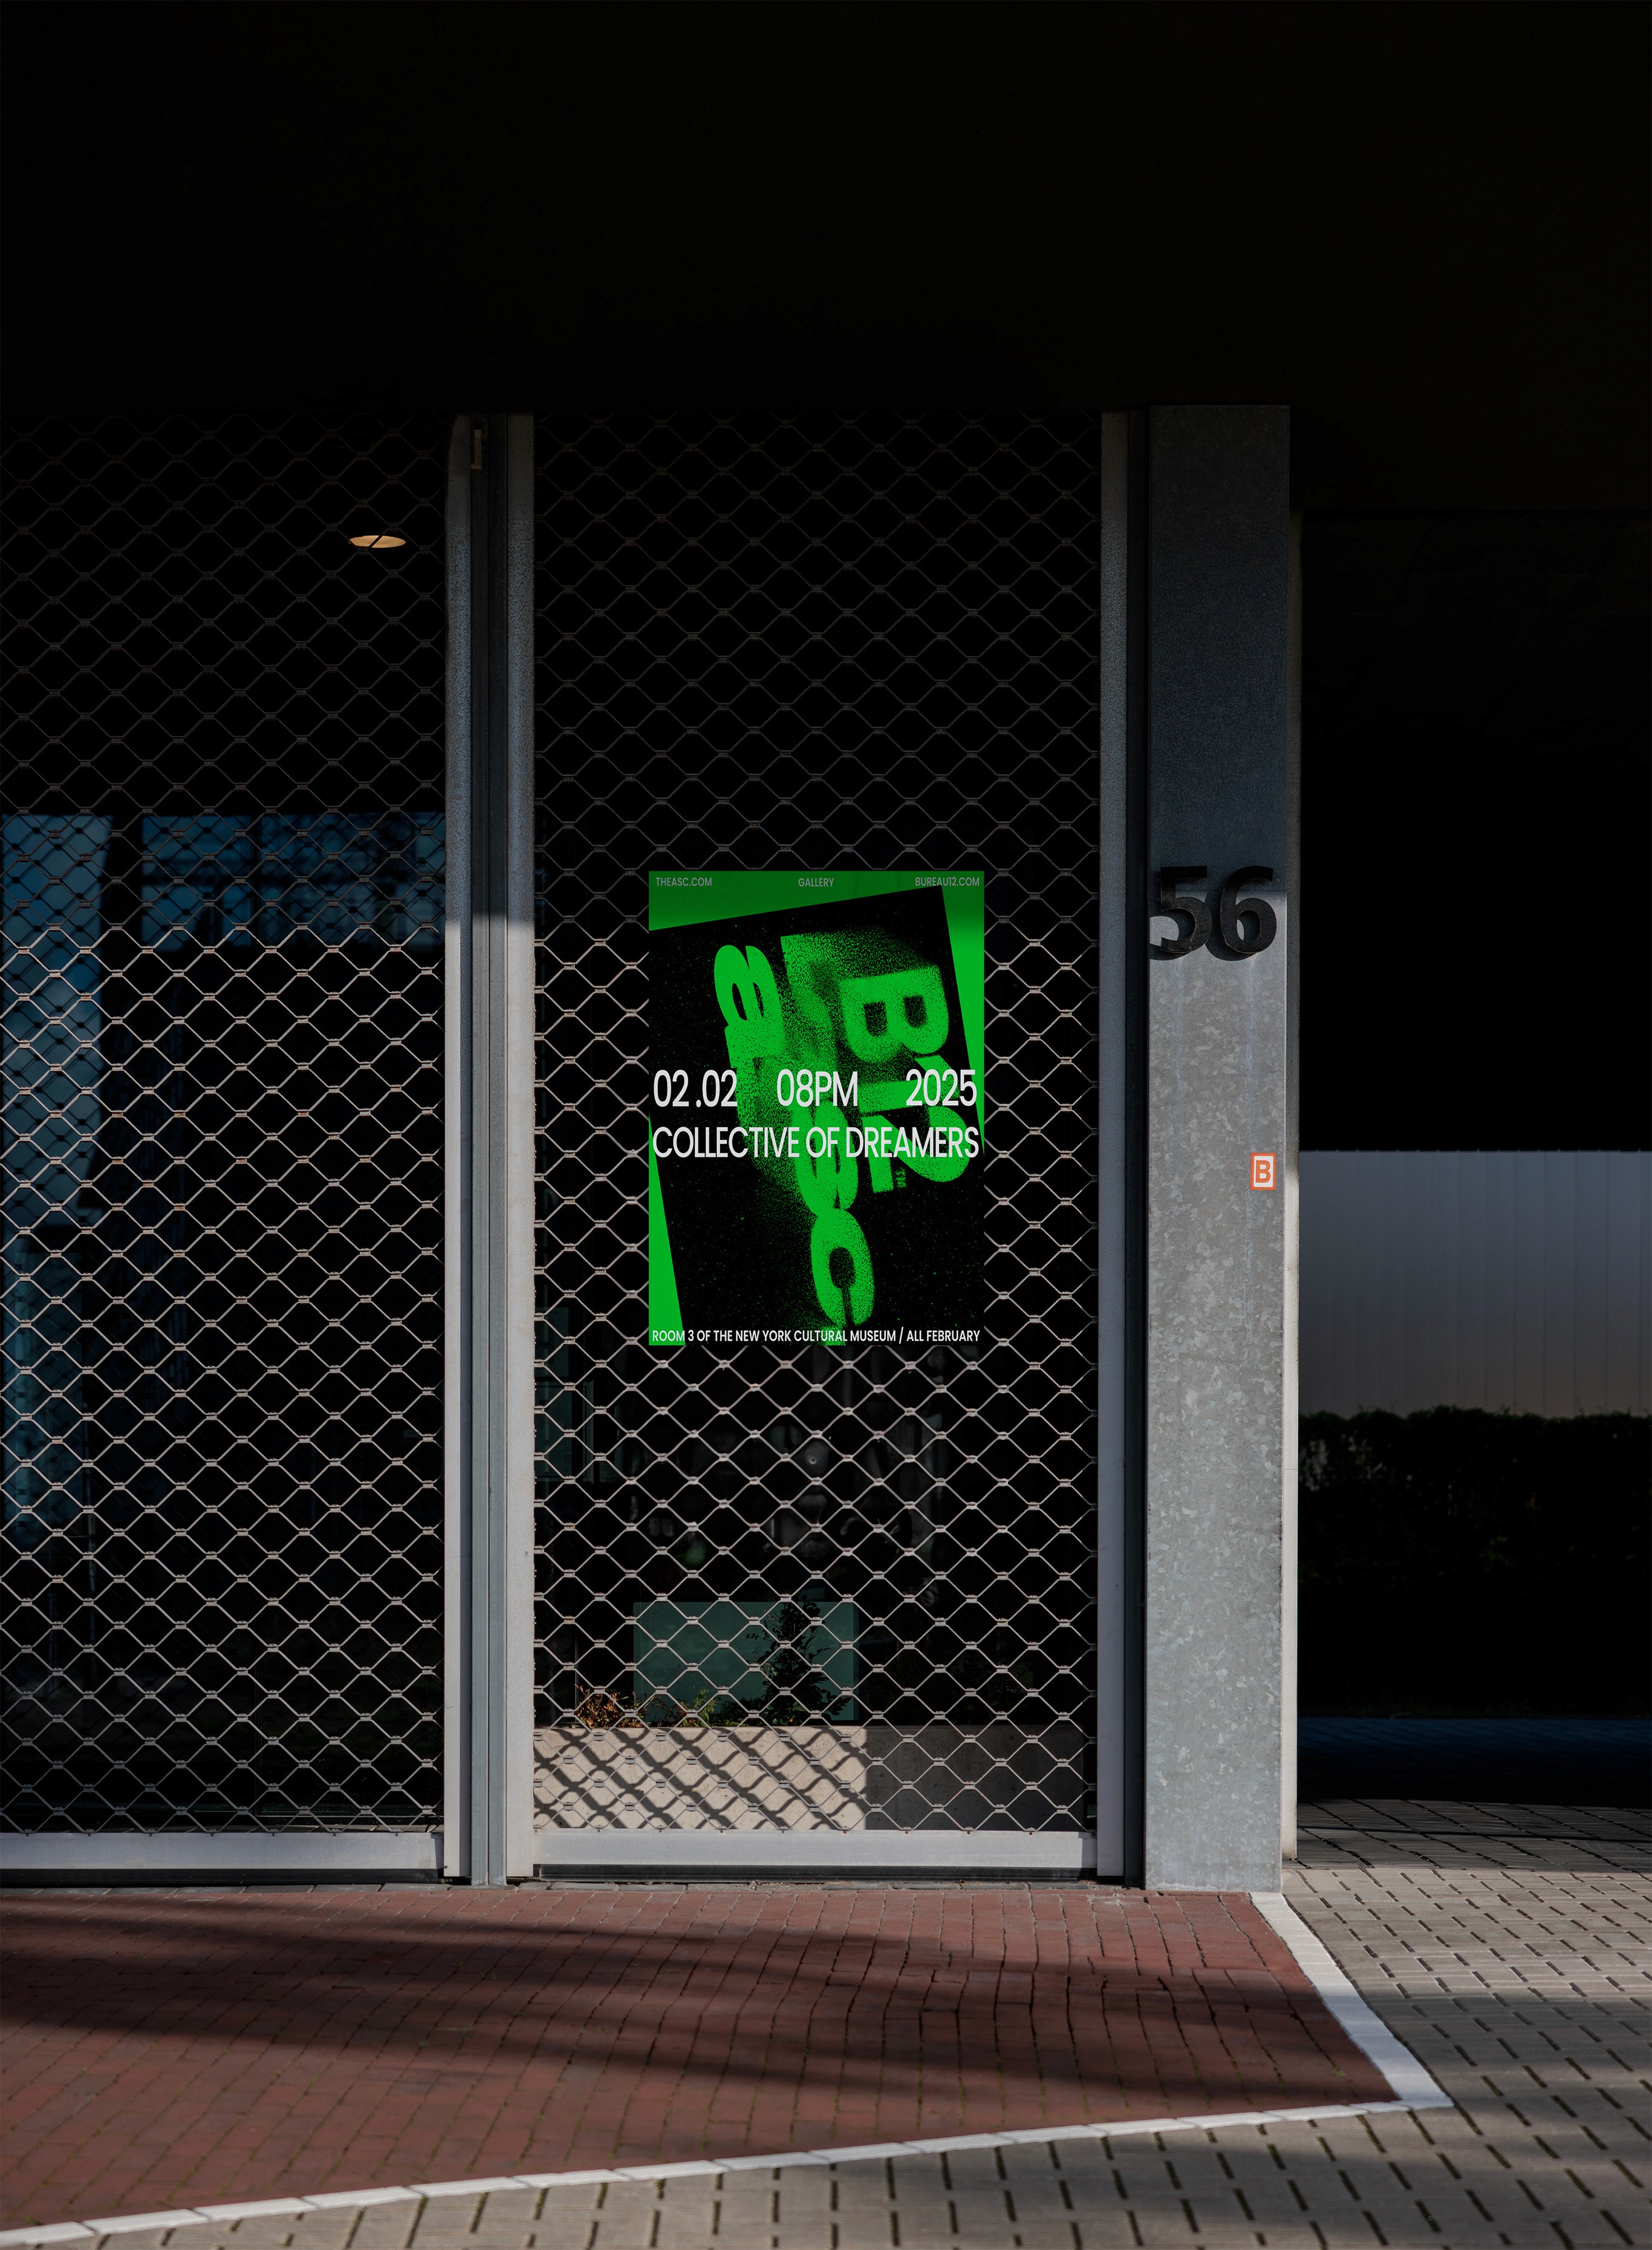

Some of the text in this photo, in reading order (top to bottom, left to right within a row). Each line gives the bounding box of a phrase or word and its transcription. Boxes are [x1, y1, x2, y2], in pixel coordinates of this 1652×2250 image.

[655, 876, 980, 887] THEASC.COM GALLERY BUREAU12.COM
[1160, 865, 1277, 954] 56
[776, 1068, 858, 1107] 08PM
[905, 1068, 977, 1107] 2025
[652, 1126, 979, 1158] COLLECTIVE OF DREAMERS
[1255, 1160, 1271, 1183] B
[652, 1330, 685, 1342] ROOM
[688, 1330, 694, 1342] 3
[697, 1330, 711, 1342] OF
[713, 1330, 733, 1342] THE
[735, 1330, 760, 1342] NEW
[762, 1330, 792, 1342] YORK
[793, 1330, 848, 1342] CULTURAL
[850, 1330, 896, 1342] MUSEUM
[906, 1330, 925, 1342] ALL
[926, 1330, 980, 1342] FEBRUARY
